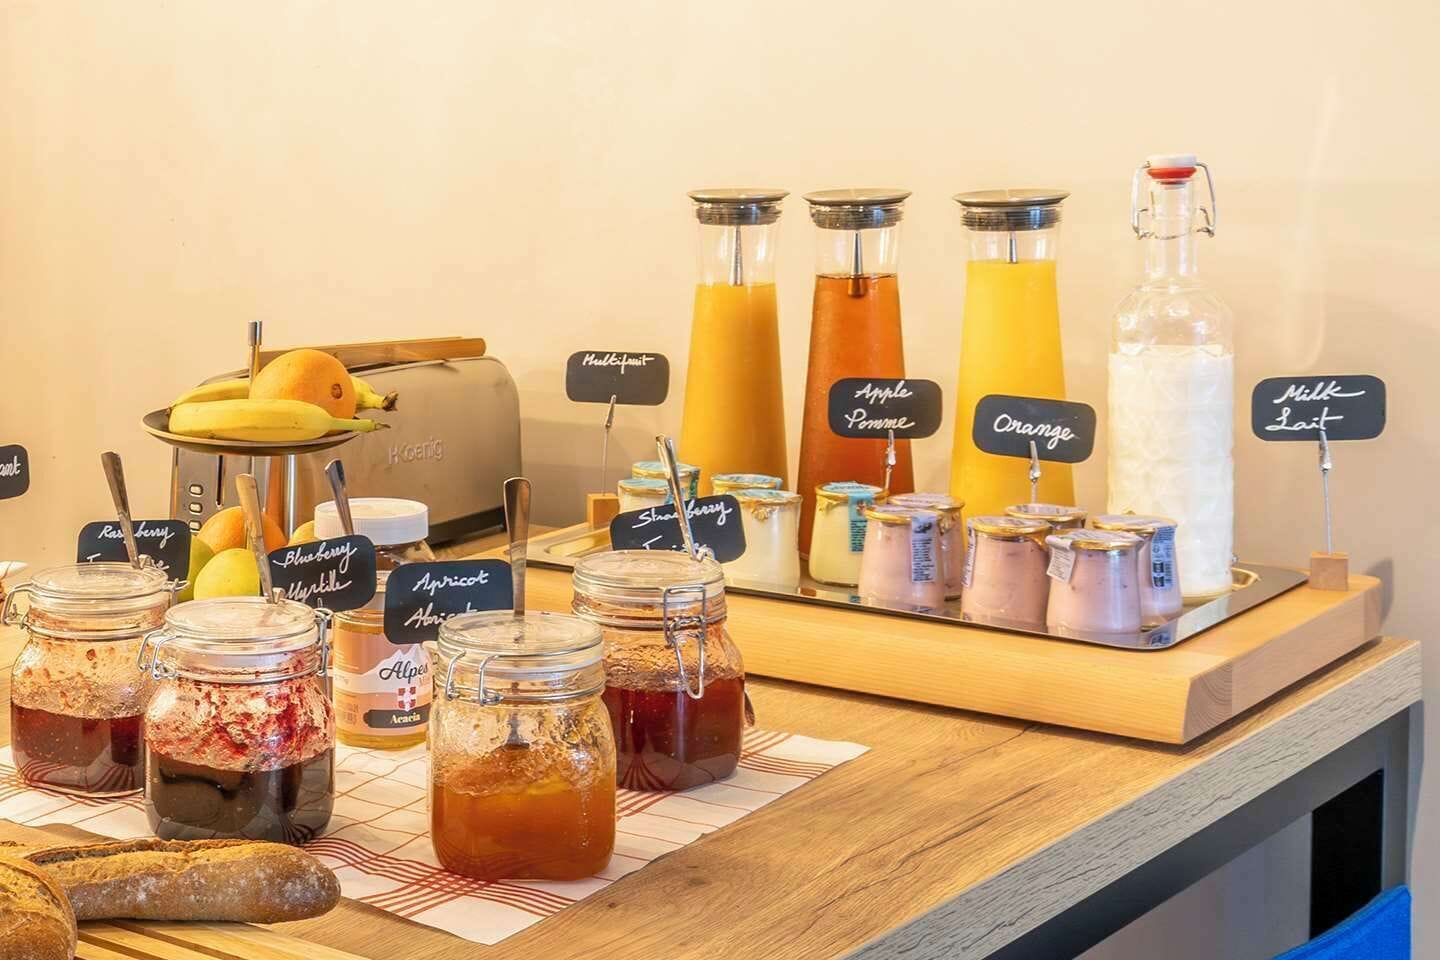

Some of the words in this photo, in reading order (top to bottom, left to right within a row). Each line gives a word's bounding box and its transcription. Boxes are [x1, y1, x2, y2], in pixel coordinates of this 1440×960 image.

[582, 353, 655, 375] Multifruit
[854, 380, 912, 404] Apple
[1272, 380, 1366, 404] Milk
[844, 407, 915, 430] Pomme
[1264, 406, 1344, 431] Lait
[993, 413, 1075, 450] Orange
[97, 521, 176, 549] Rasberry
[272, 541, 358, 574] Blueberry
[412, 569, 490, 597] Apricot
[379, 660, 428, 684] Alpes
[390, 711, 421, 724] Acacia
